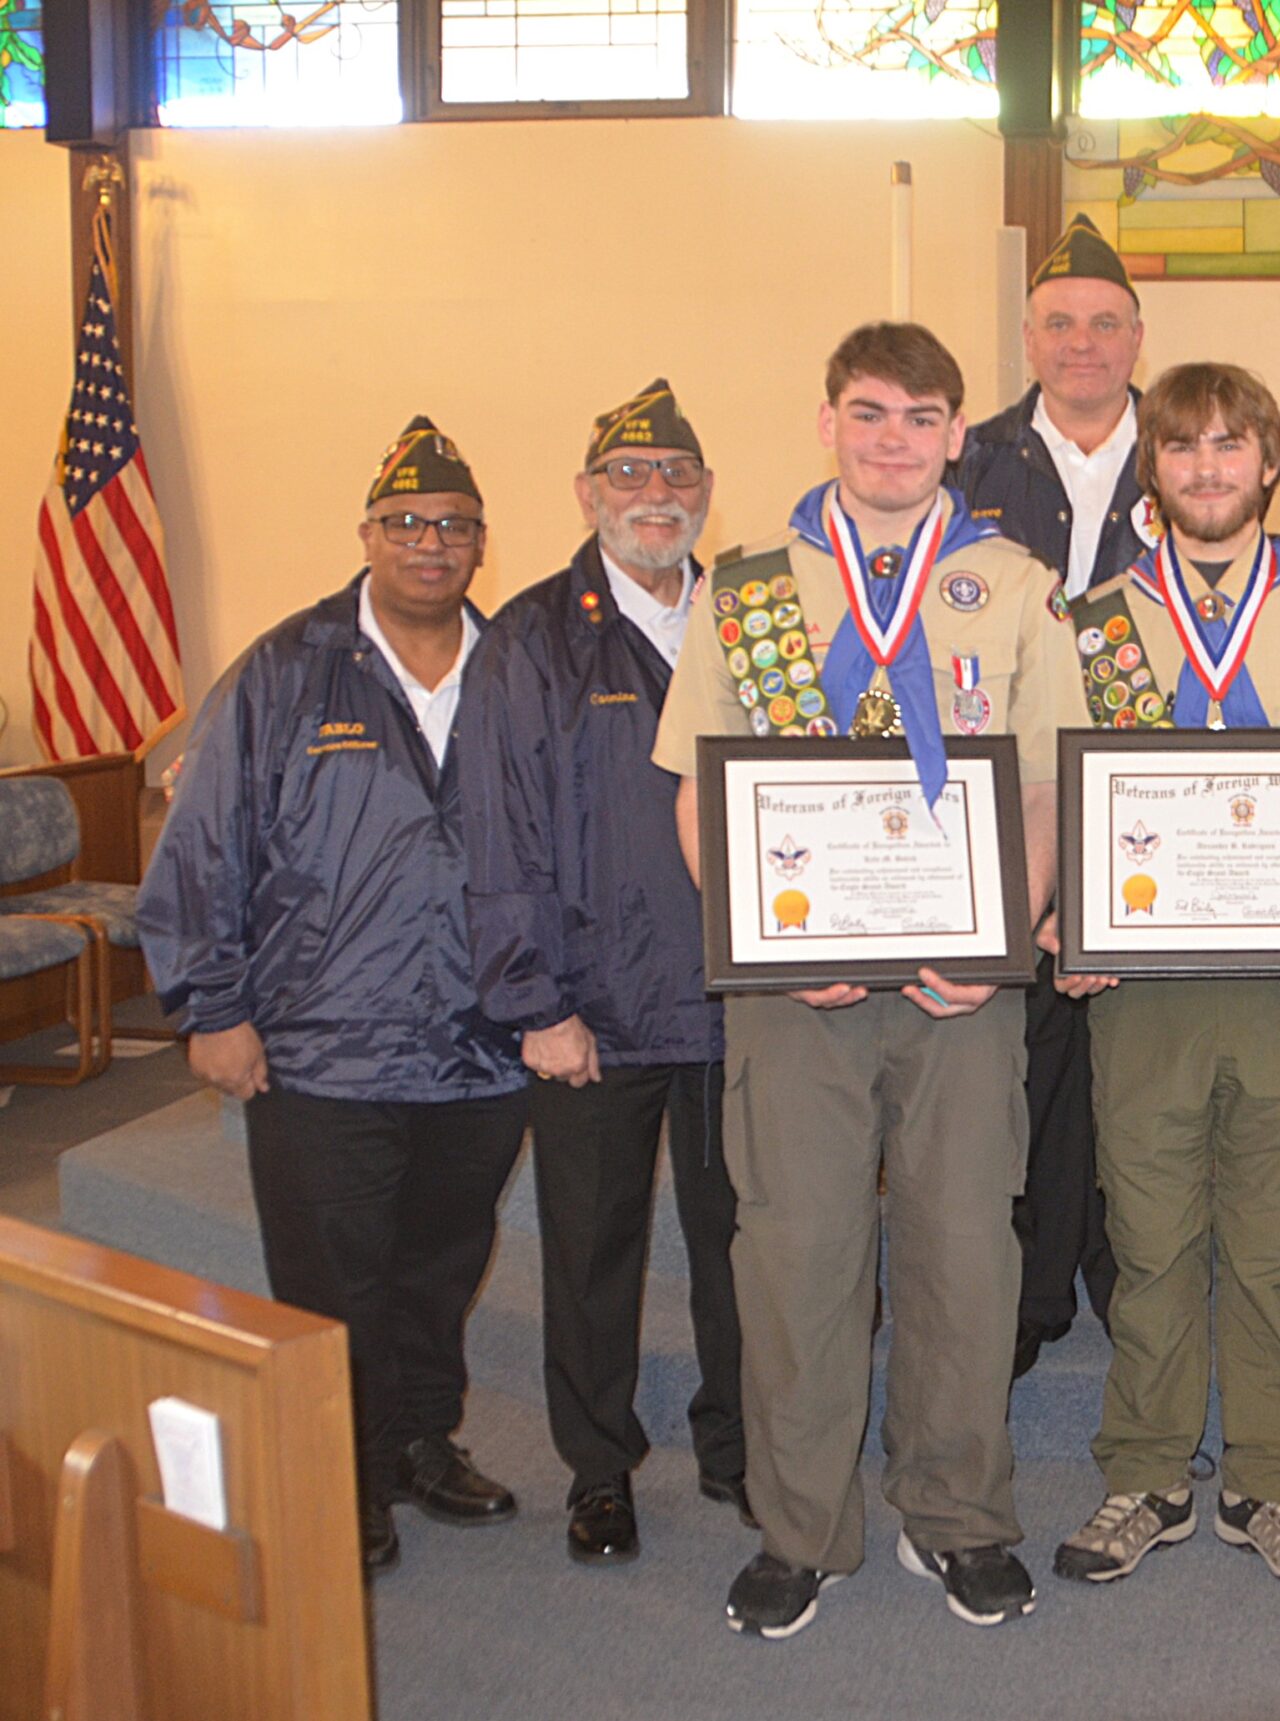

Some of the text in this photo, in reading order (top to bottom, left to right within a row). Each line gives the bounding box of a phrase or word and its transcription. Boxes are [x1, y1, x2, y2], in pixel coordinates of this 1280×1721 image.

[621, 431, 653, 442] 4662
[1112, 779, 1176, 800] Veterans
[1183, 781, 1198, 797] of
[1201, 776, 1260, 799] Foreign
[757, 793, 824, 814] Veterans
[832, 793, 847, 811] of
[851, 787, 911, 812] Foreign
